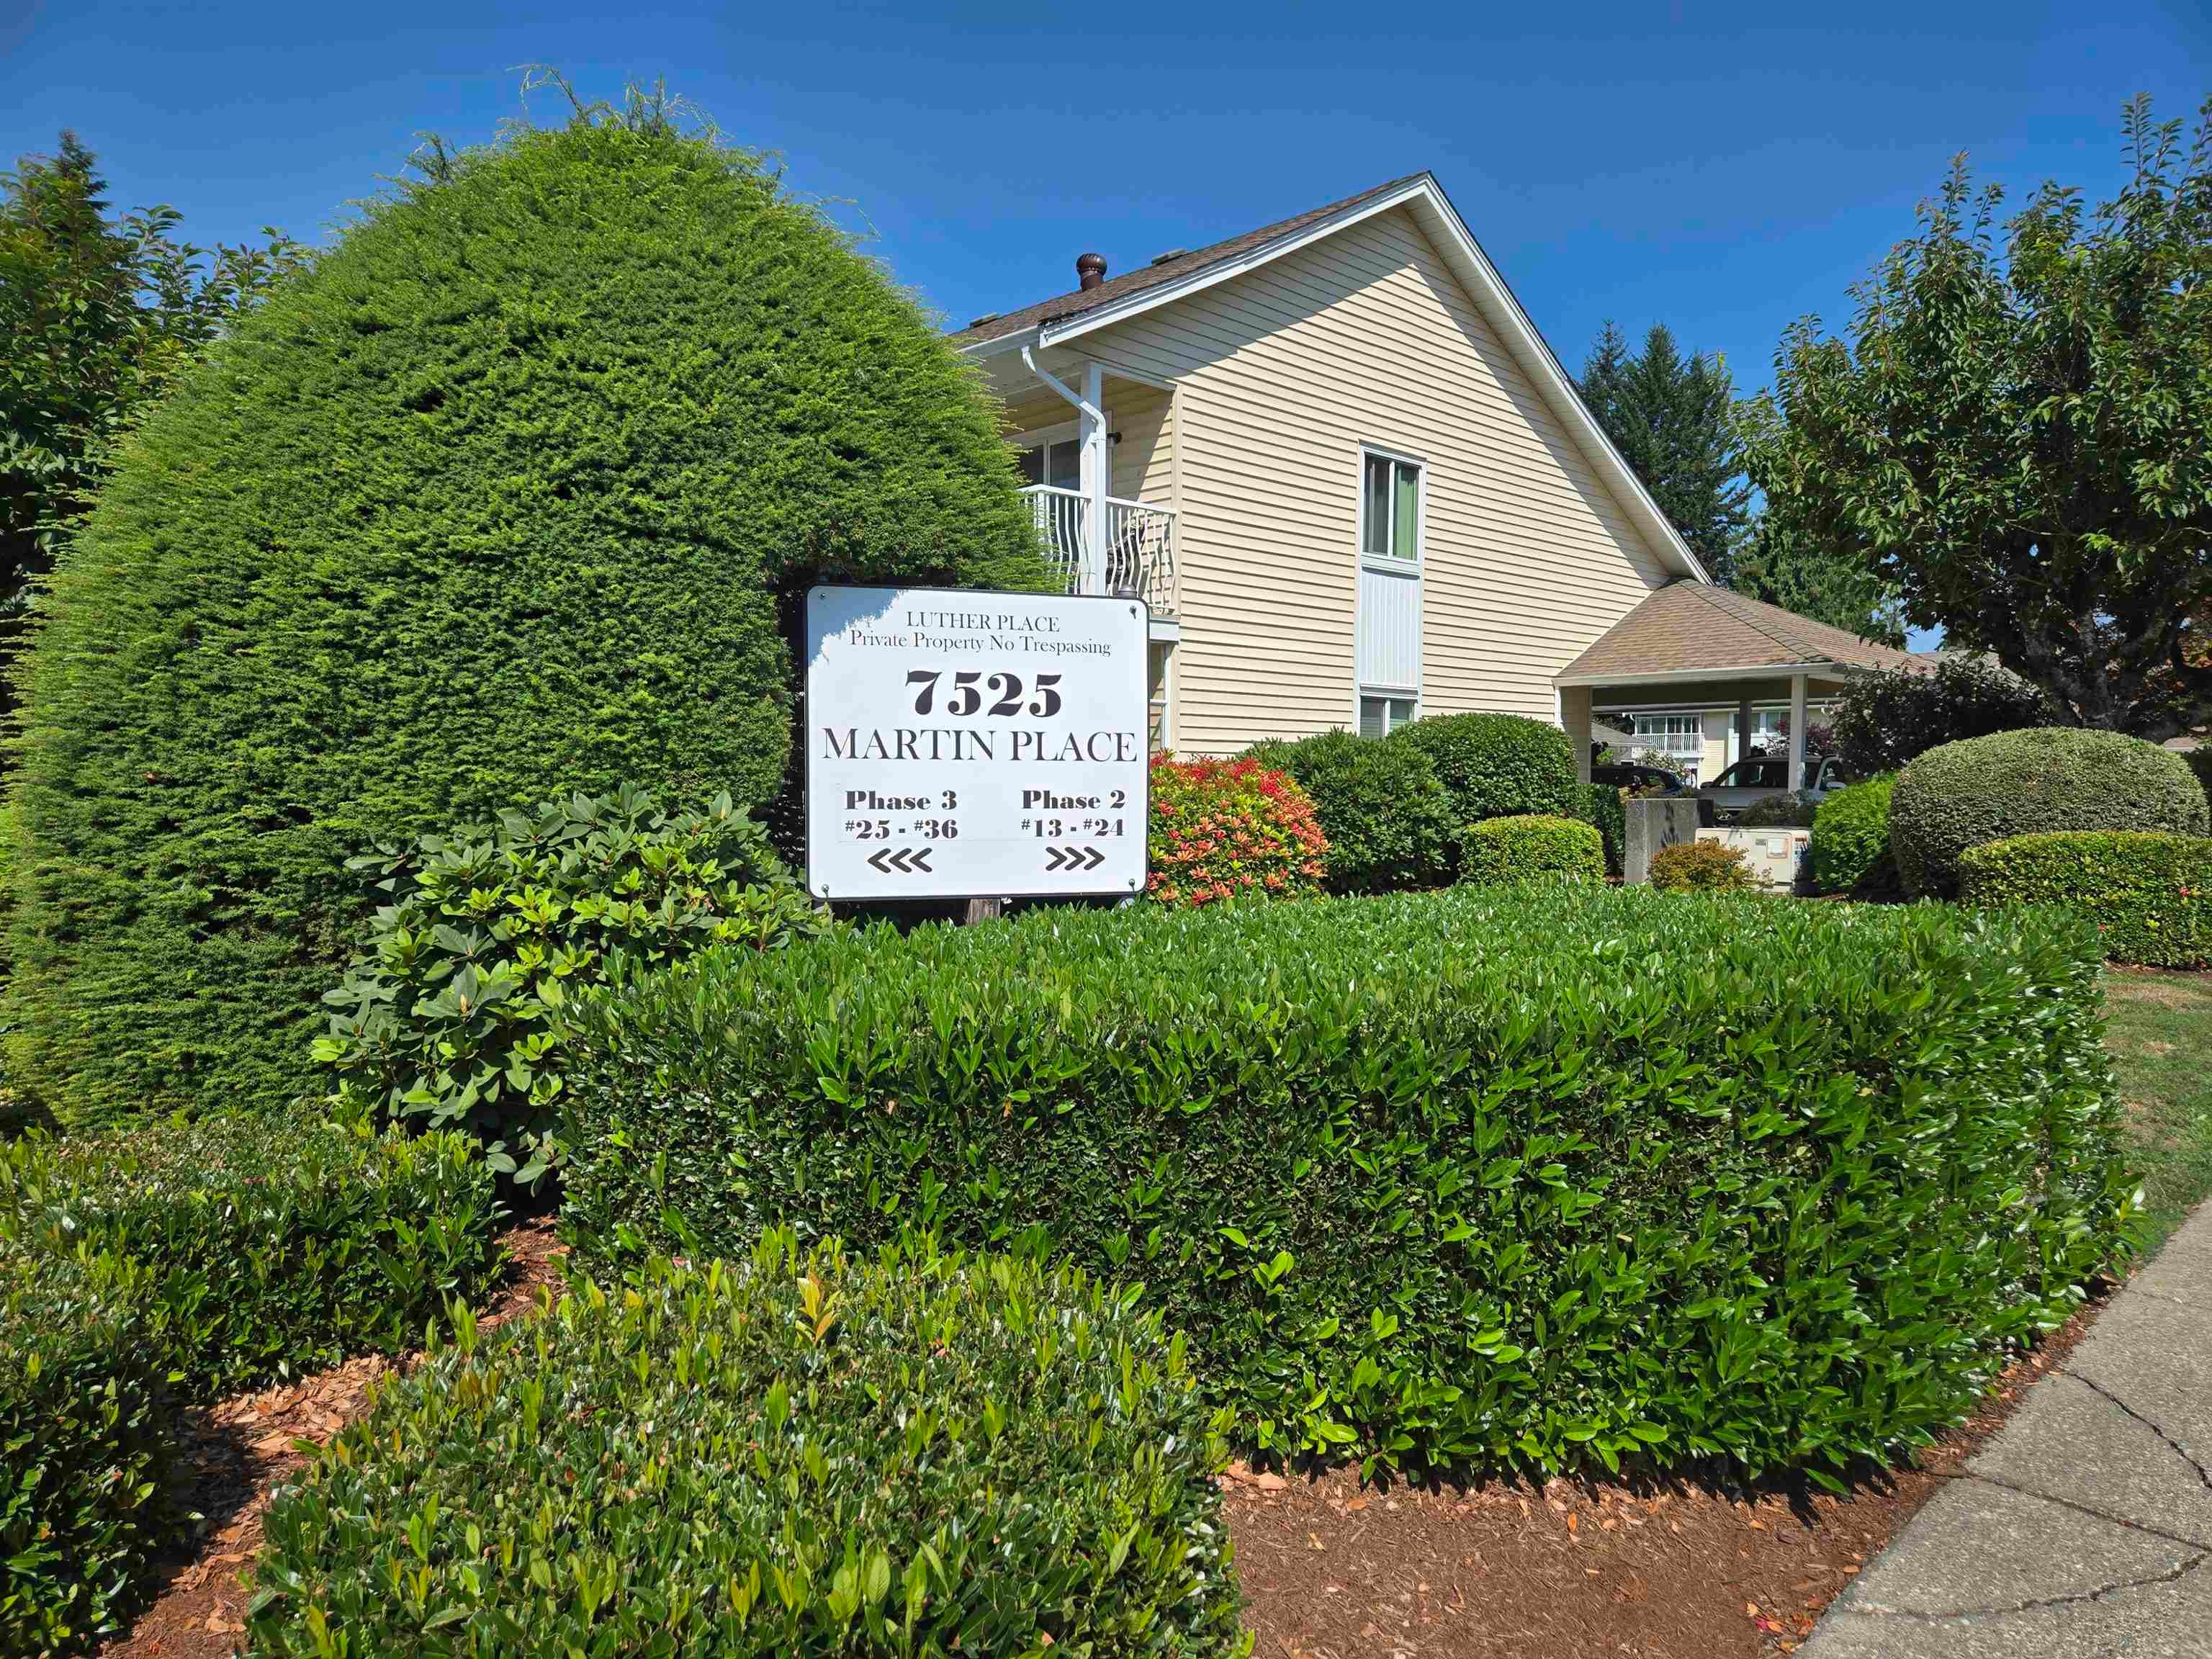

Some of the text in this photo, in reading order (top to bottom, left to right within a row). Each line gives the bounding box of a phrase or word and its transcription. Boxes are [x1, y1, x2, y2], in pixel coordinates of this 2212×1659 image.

[907, 611, 1061, 632] LUTHER PLACE
[850, 629, 1112, 657] Private Property No Trespassing
[905, 670, 1062, 718] 7525
[822, 727, 1138, 762] MARTIN PLACE
[845, 790, 957, 810] Phase 3
[1022, 790, 1125, 809] Phase 2
[845, 819, 890, 840] #25
[914, 819, 958, 840] #36
[1021, 819, 1063, 837] #13
[1083, 818, 1123, 837] #24
